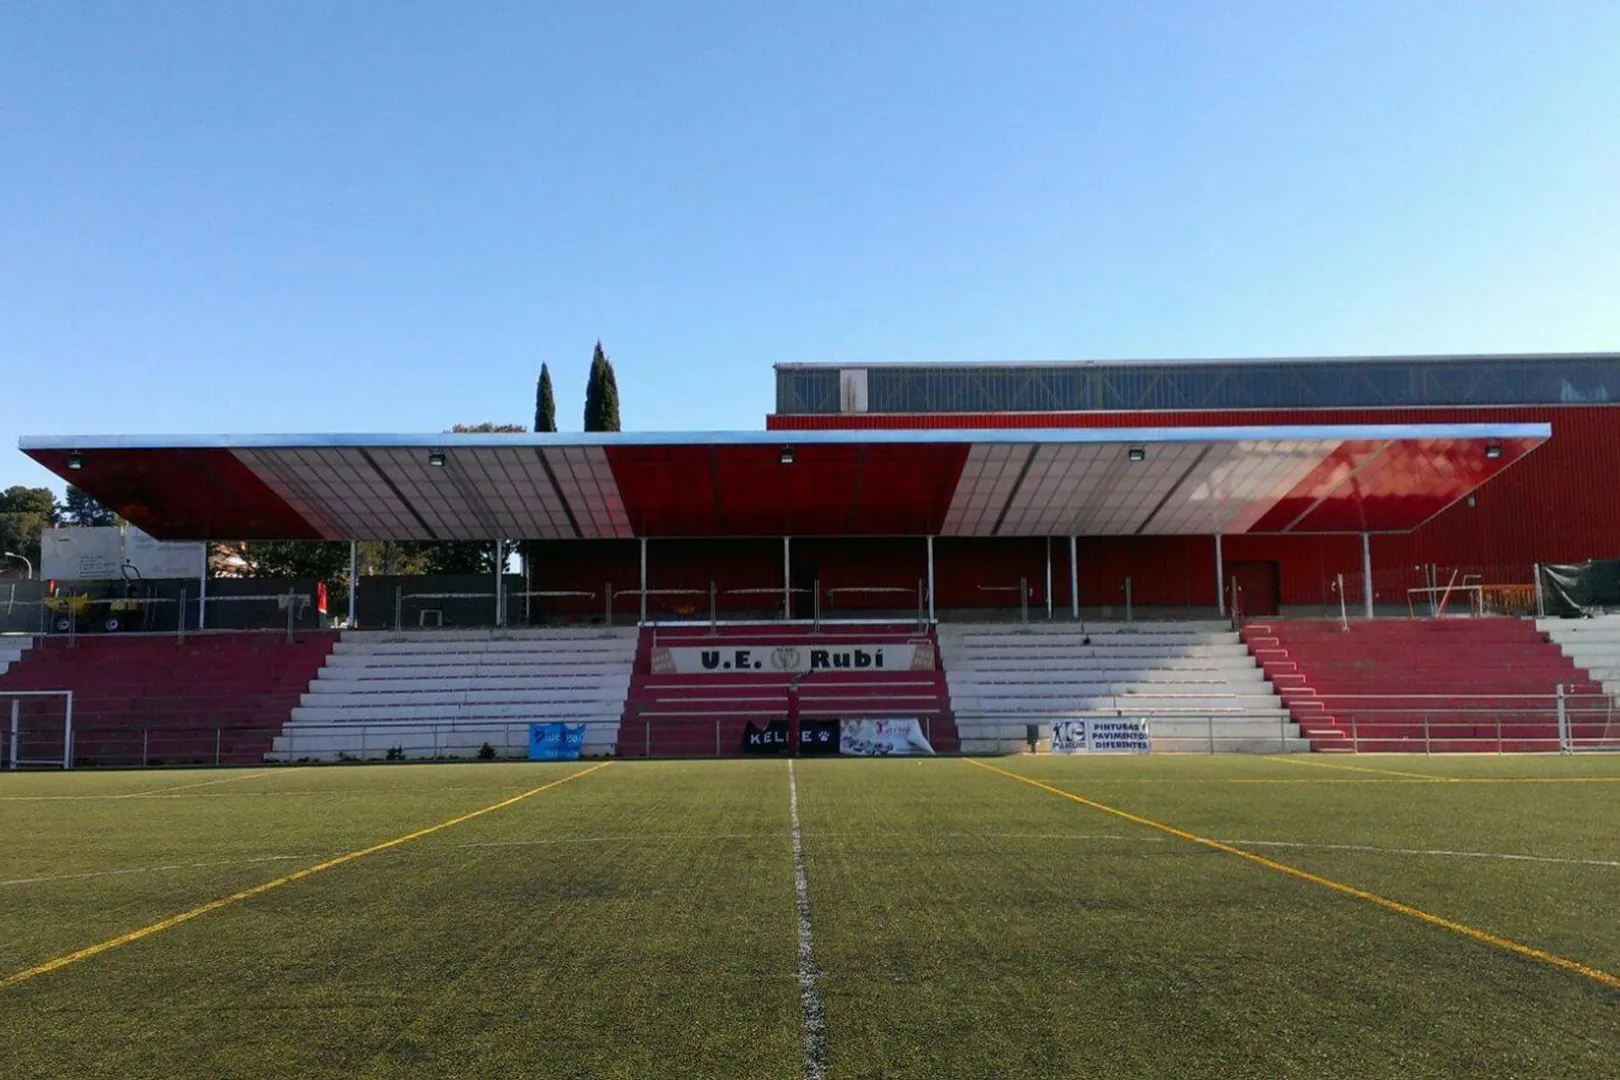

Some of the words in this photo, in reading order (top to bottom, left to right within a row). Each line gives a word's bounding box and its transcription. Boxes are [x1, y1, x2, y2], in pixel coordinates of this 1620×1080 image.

[701, 650, 762, 670] U.E.
[810, 648, 884, 669] Rubí
[1093, 723, 1139, 731] PINTURAS
[749, 730, 812, 745] KELE
[1094, 741, 1148, 749] DIFERENTES
